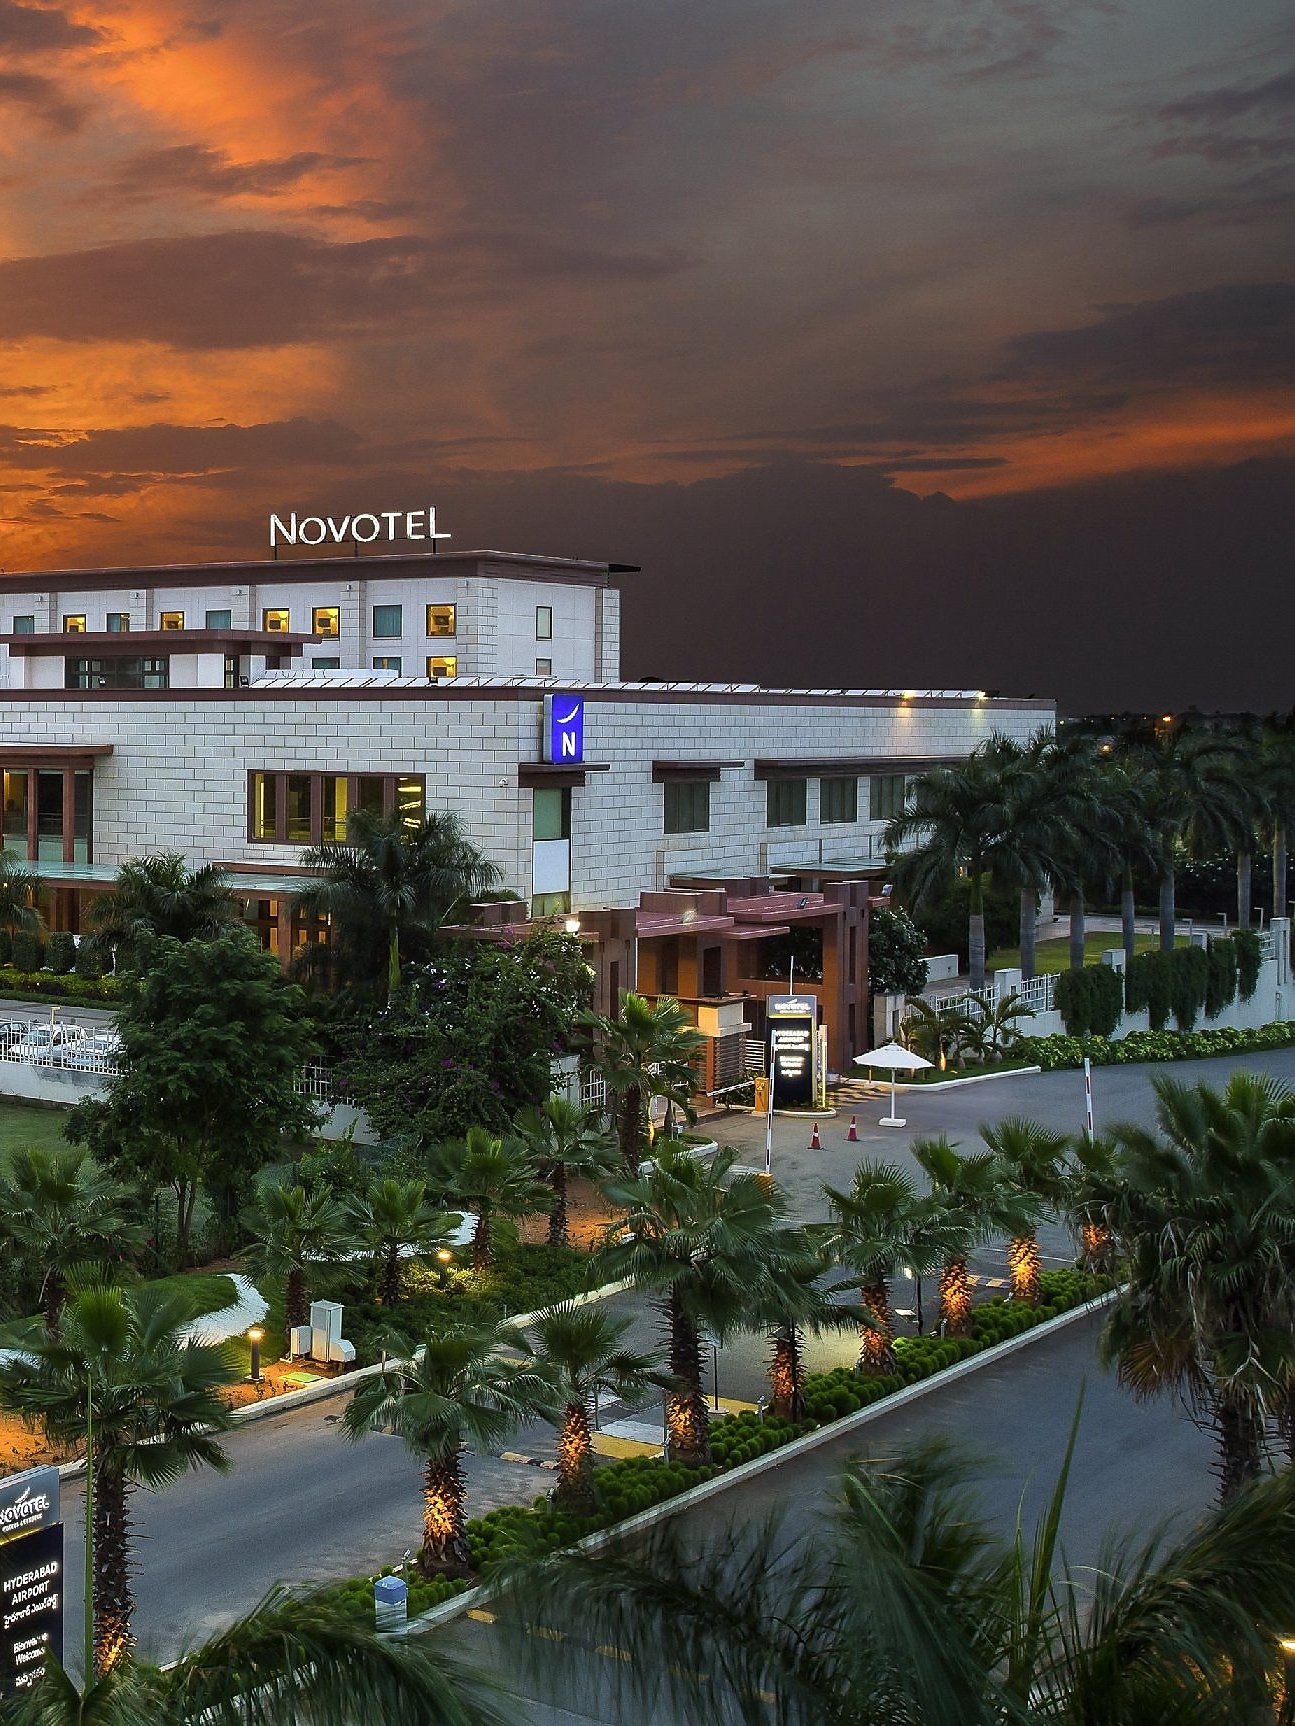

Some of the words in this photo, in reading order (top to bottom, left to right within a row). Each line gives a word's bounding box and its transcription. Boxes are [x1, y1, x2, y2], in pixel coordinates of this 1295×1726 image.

[270, 506, 451, 547] NOVOTEL
[562, 731, 576, 757] N
[3, 1561, 59, 1592] HYDERABAD
[11, 1580, 50, 1605] AIRPORT
